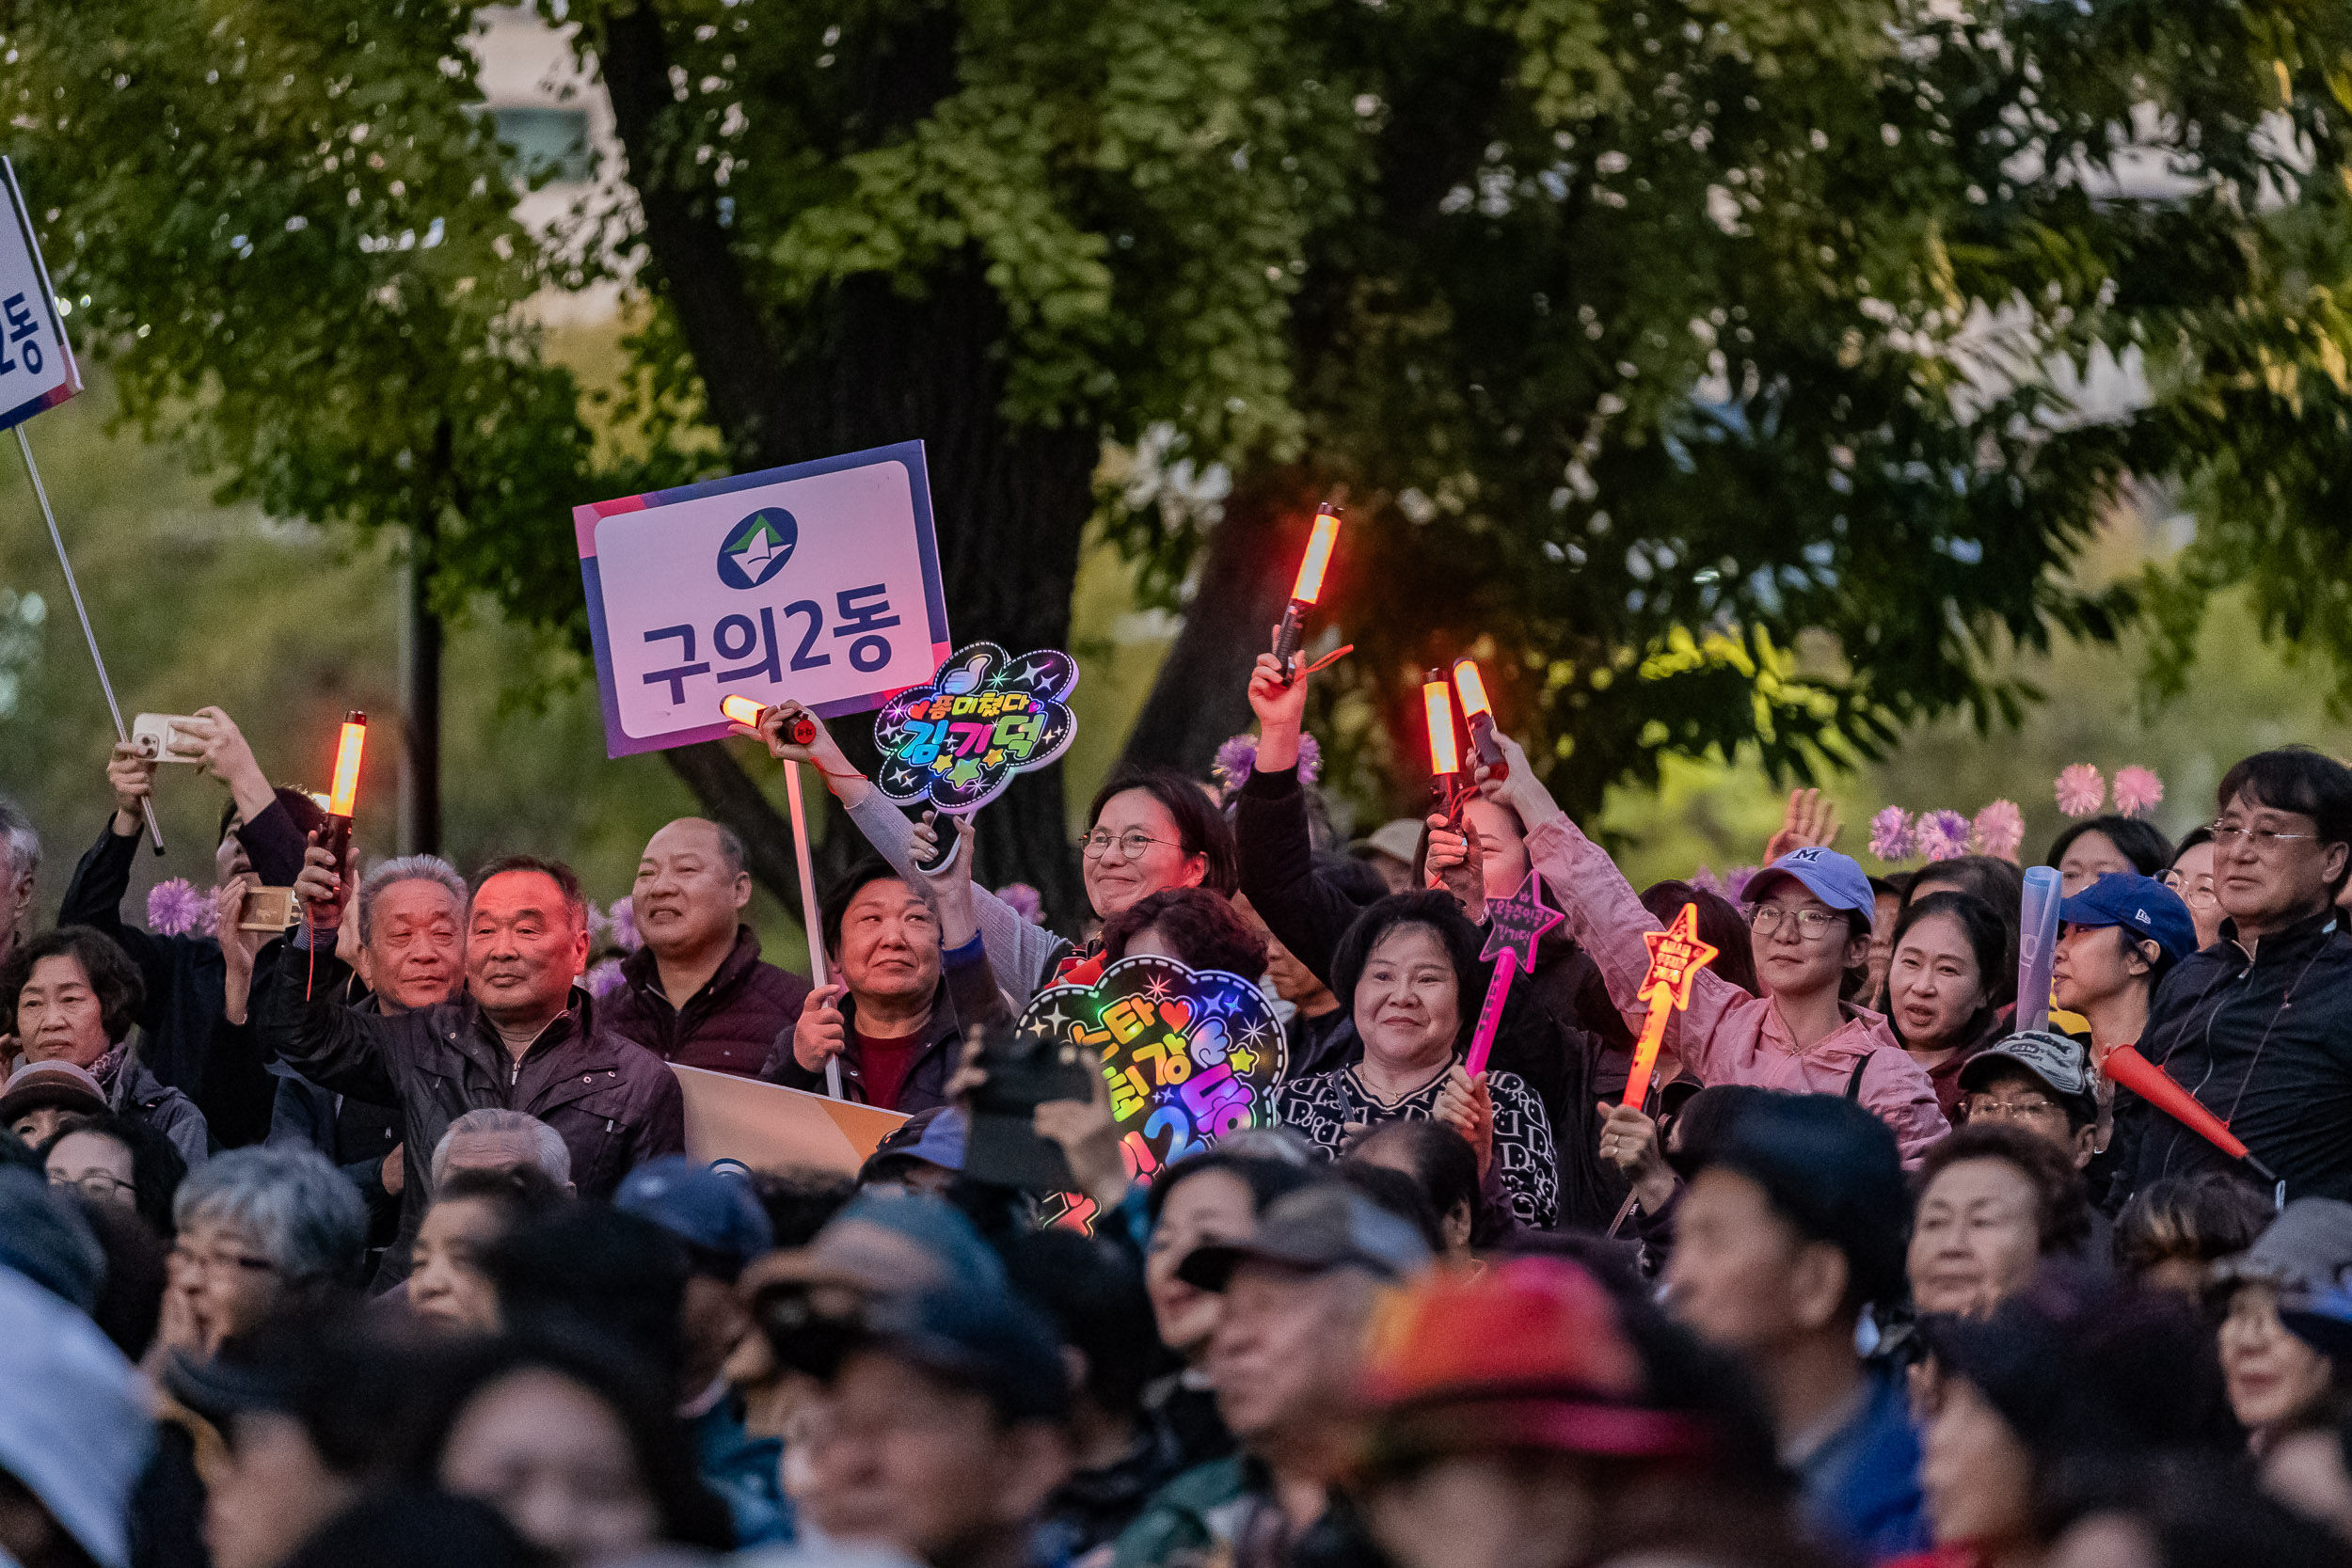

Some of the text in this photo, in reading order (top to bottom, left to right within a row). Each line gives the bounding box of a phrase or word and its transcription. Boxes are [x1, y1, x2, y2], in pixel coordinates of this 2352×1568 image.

[643, 583, 900, 705] 구의2동
[898, 714, 1045, 765] 김기덕
[1791, 848, 1823, 863] M
